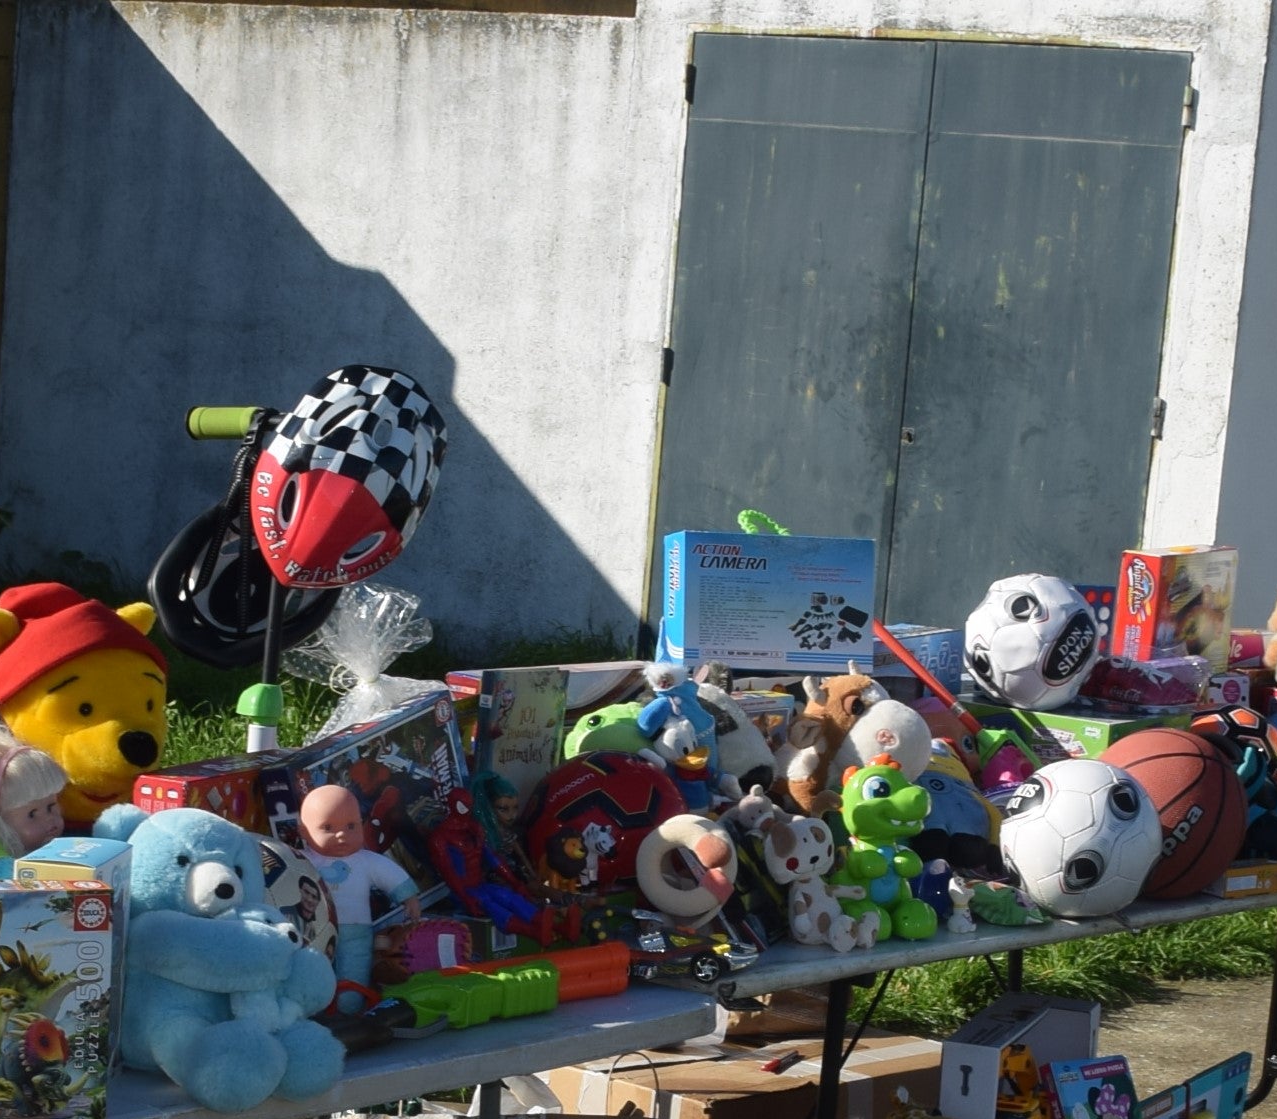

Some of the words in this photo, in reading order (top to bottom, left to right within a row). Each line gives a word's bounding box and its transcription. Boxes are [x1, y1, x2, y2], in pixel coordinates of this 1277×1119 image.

[693, 543, 741, 556] ACTION
[700, 555, 767, 571] CAMERA
[1057, 624, 1096, 677] SIMON
[1058, 626, 1083, 657] DON
[499, 746, 543, 765] animales
[75, 940, 105, 1002] 500
[74, 1011, 85, 1070] EDUCA
[87, 1010, 101, 1075] PUZZLE
